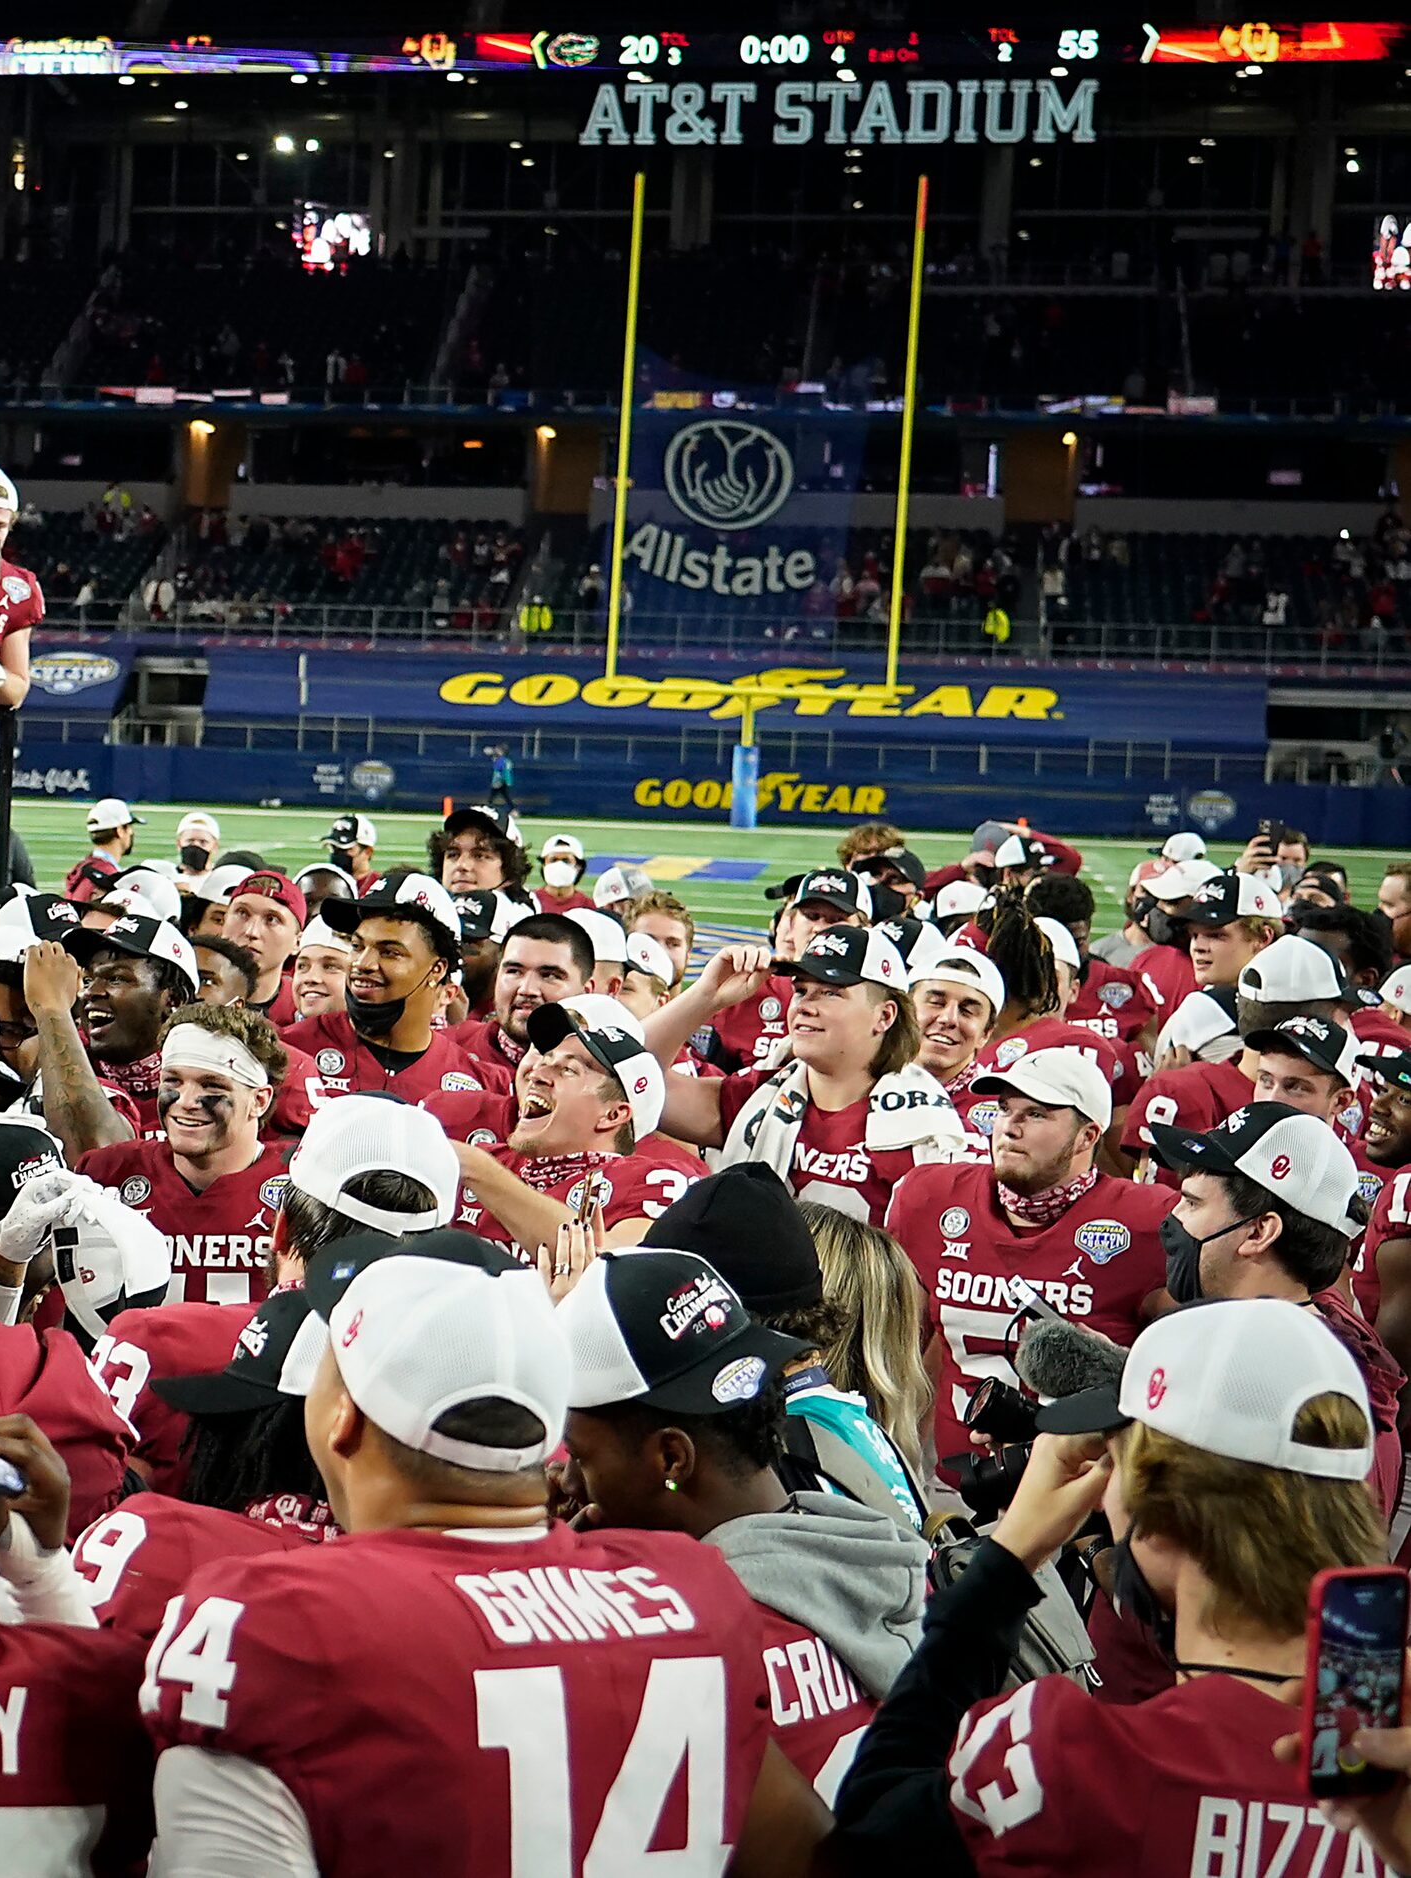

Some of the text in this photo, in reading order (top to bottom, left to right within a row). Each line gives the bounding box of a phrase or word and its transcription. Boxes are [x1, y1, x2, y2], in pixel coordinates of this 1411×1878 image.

[619, 35, 660, 64] 20
[667, 47, 682, 66] 3
[740, 35, 810, 64] 0:00
[831, 46, 846, 63] 4
[998, 42, 1013, 62] 2
[1058, 29, 1099, 60] 55
[578, 78, 1100, 146] AT&T STADIUM
[623, 523, 816, 596] Allstate
[439, 668, 1061, 720] GOODYEAR
[642, 1169, 703, 1219] 3
[1387, 1173, 1411, 1223] 1
[456, 1204, 483, 1226] XII
[941, 1240, 971, 1261] XII
[667, 1289, 698, 1313] Cotton
[692, 1318, 708, 1335] 20
[455, 1566, 696, 1646] GRIMES
[138, 1594, 245, 1730] 14
[473, 1655, 735, 1878] 14
[1189, 1795, 1401, 1878] BIZZA
